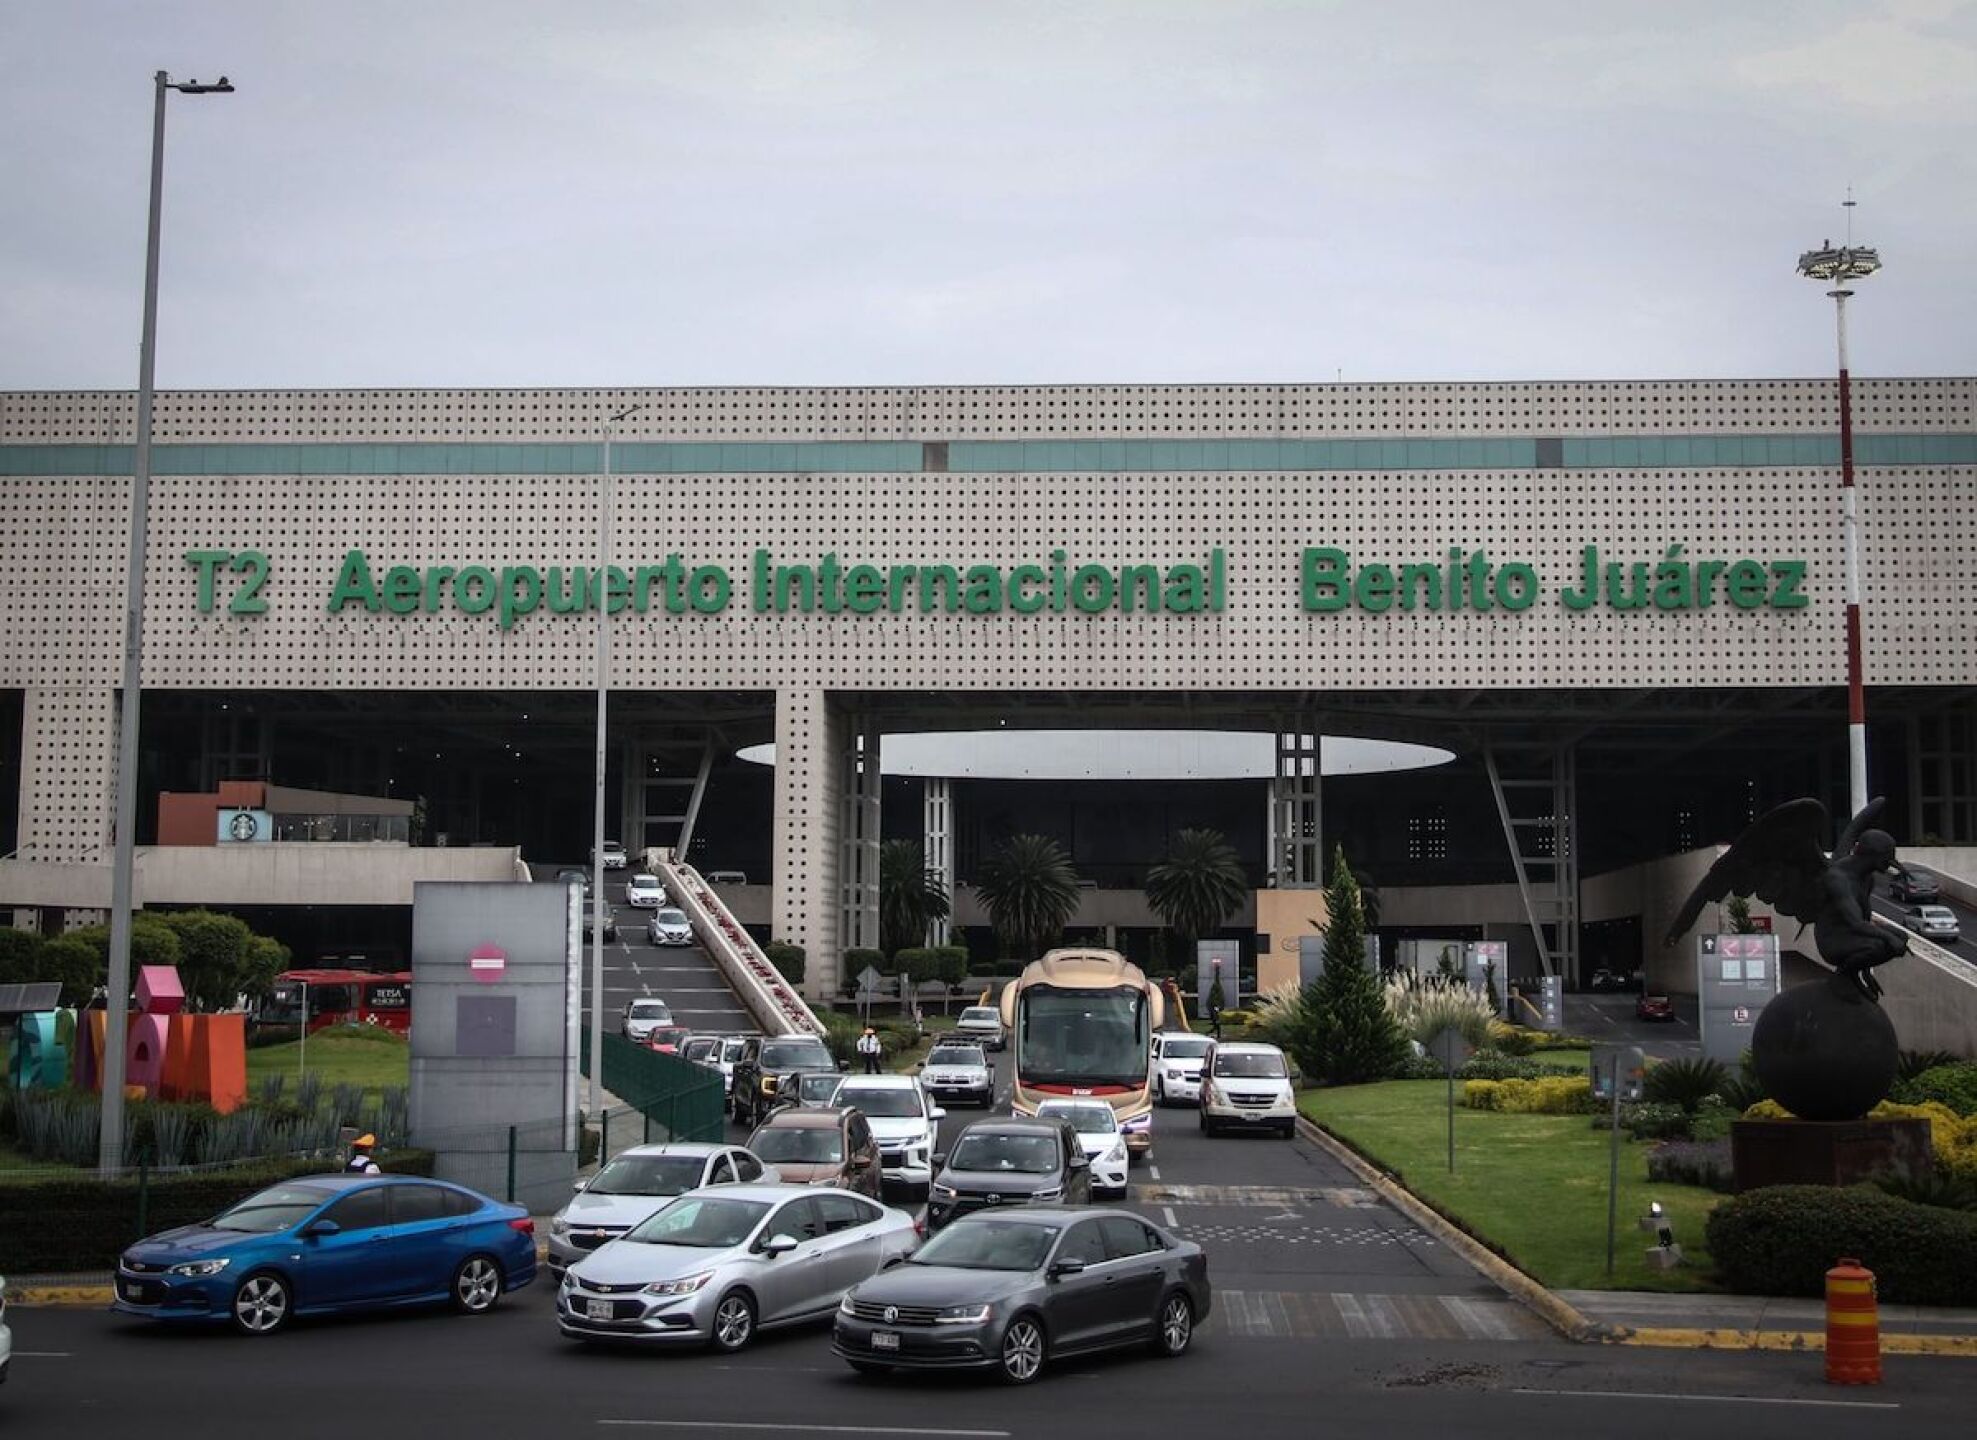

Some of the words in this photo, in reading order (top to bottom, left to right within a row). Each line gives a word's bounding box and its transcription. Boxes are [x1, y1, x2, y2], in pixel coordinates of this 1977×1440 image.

[187, 550, 270, 614] T2
[326, 549, 732, 631] Aeropuerto
[755, 549, 1224, 614] Internacional
[1303, 548, 1537, 613] Benito
[1563, 546, 1808, 609] Juárez
